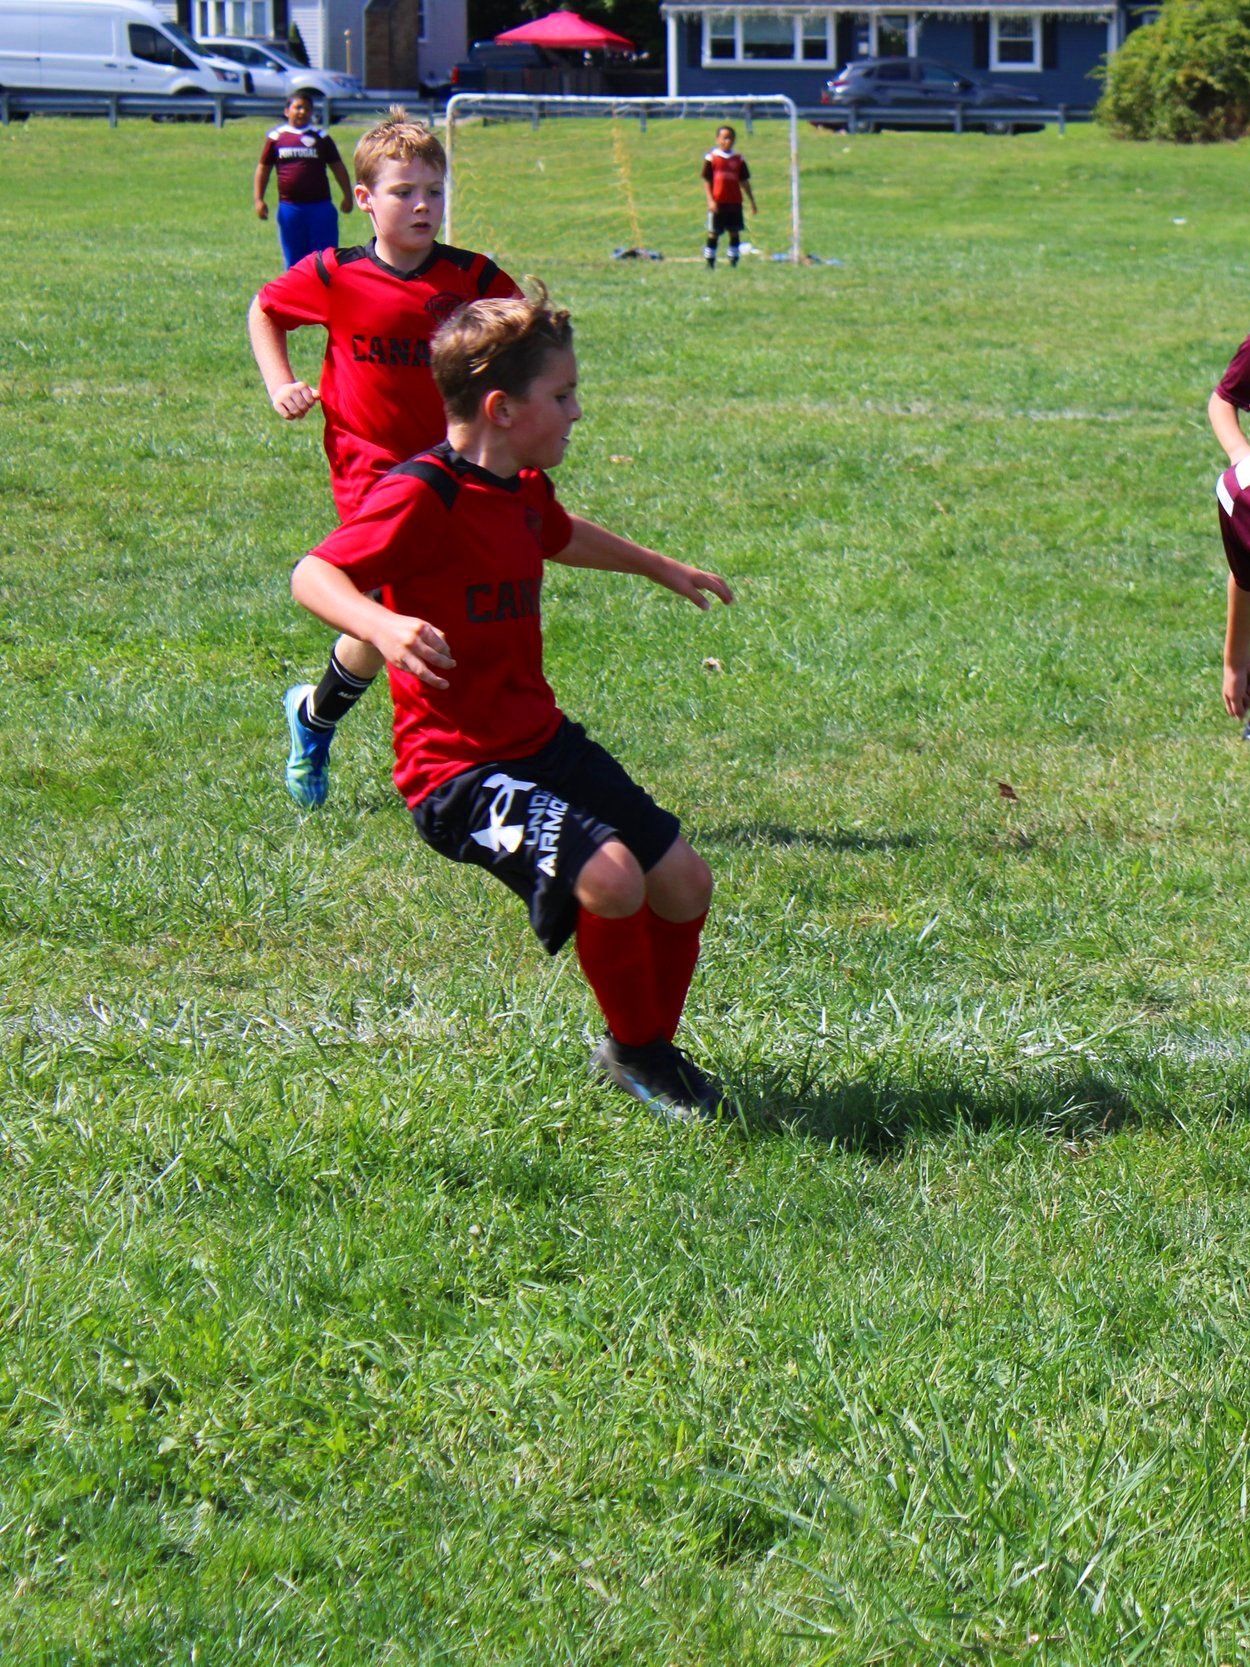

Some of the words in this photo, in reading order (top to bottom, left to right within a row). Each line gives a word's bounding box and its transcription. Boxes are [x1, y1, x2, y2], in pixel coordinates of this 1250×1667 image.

[278, 147, 318, 159] PORTUGAL
[352, 335, 430, 367] CANA
[466, 576, 542, 623] CAN
[524, 790, 549, 846] UND
[537, 797, 569, 877] ARMO
